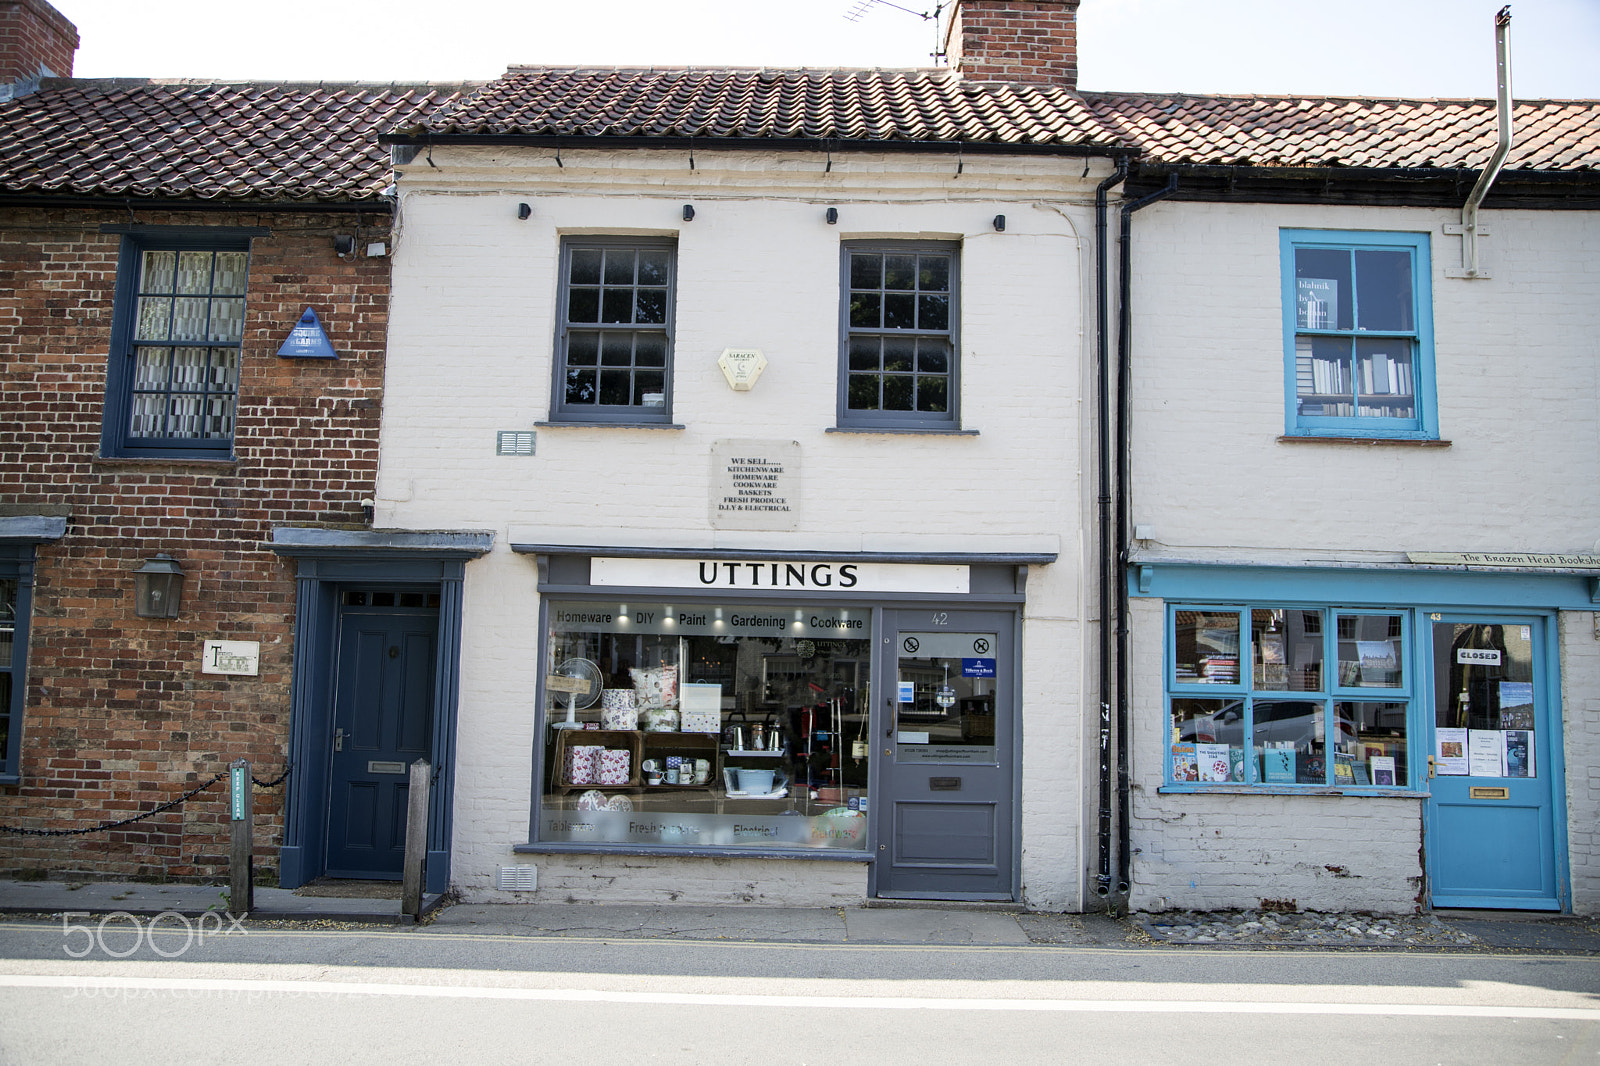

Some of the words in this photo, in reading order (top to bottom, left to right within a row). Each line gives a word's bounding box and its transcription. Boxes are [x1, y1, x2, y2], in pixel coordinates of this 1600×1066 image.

[1299, 280, 1330, 290] blahnik
[1461, 554, 1480, 562] The
[1527, 555, 1556, 564] Head
[699, 561, 858, 588] UTTINGS
[557, 610, 612, 624] Homeware
[636, 612, 654, 624] DIY
[679, 613, 707, 626] Paint
[731, 614, 786, 630] Gardening
[810, 616, 863, 629] Cookware
[931, 612, 948, 625] 42
[1430, 612, 1442, 621] 43
[1460, 651, 1498, 660] CLOSED
[630, 822, 656, 833] Fresh
